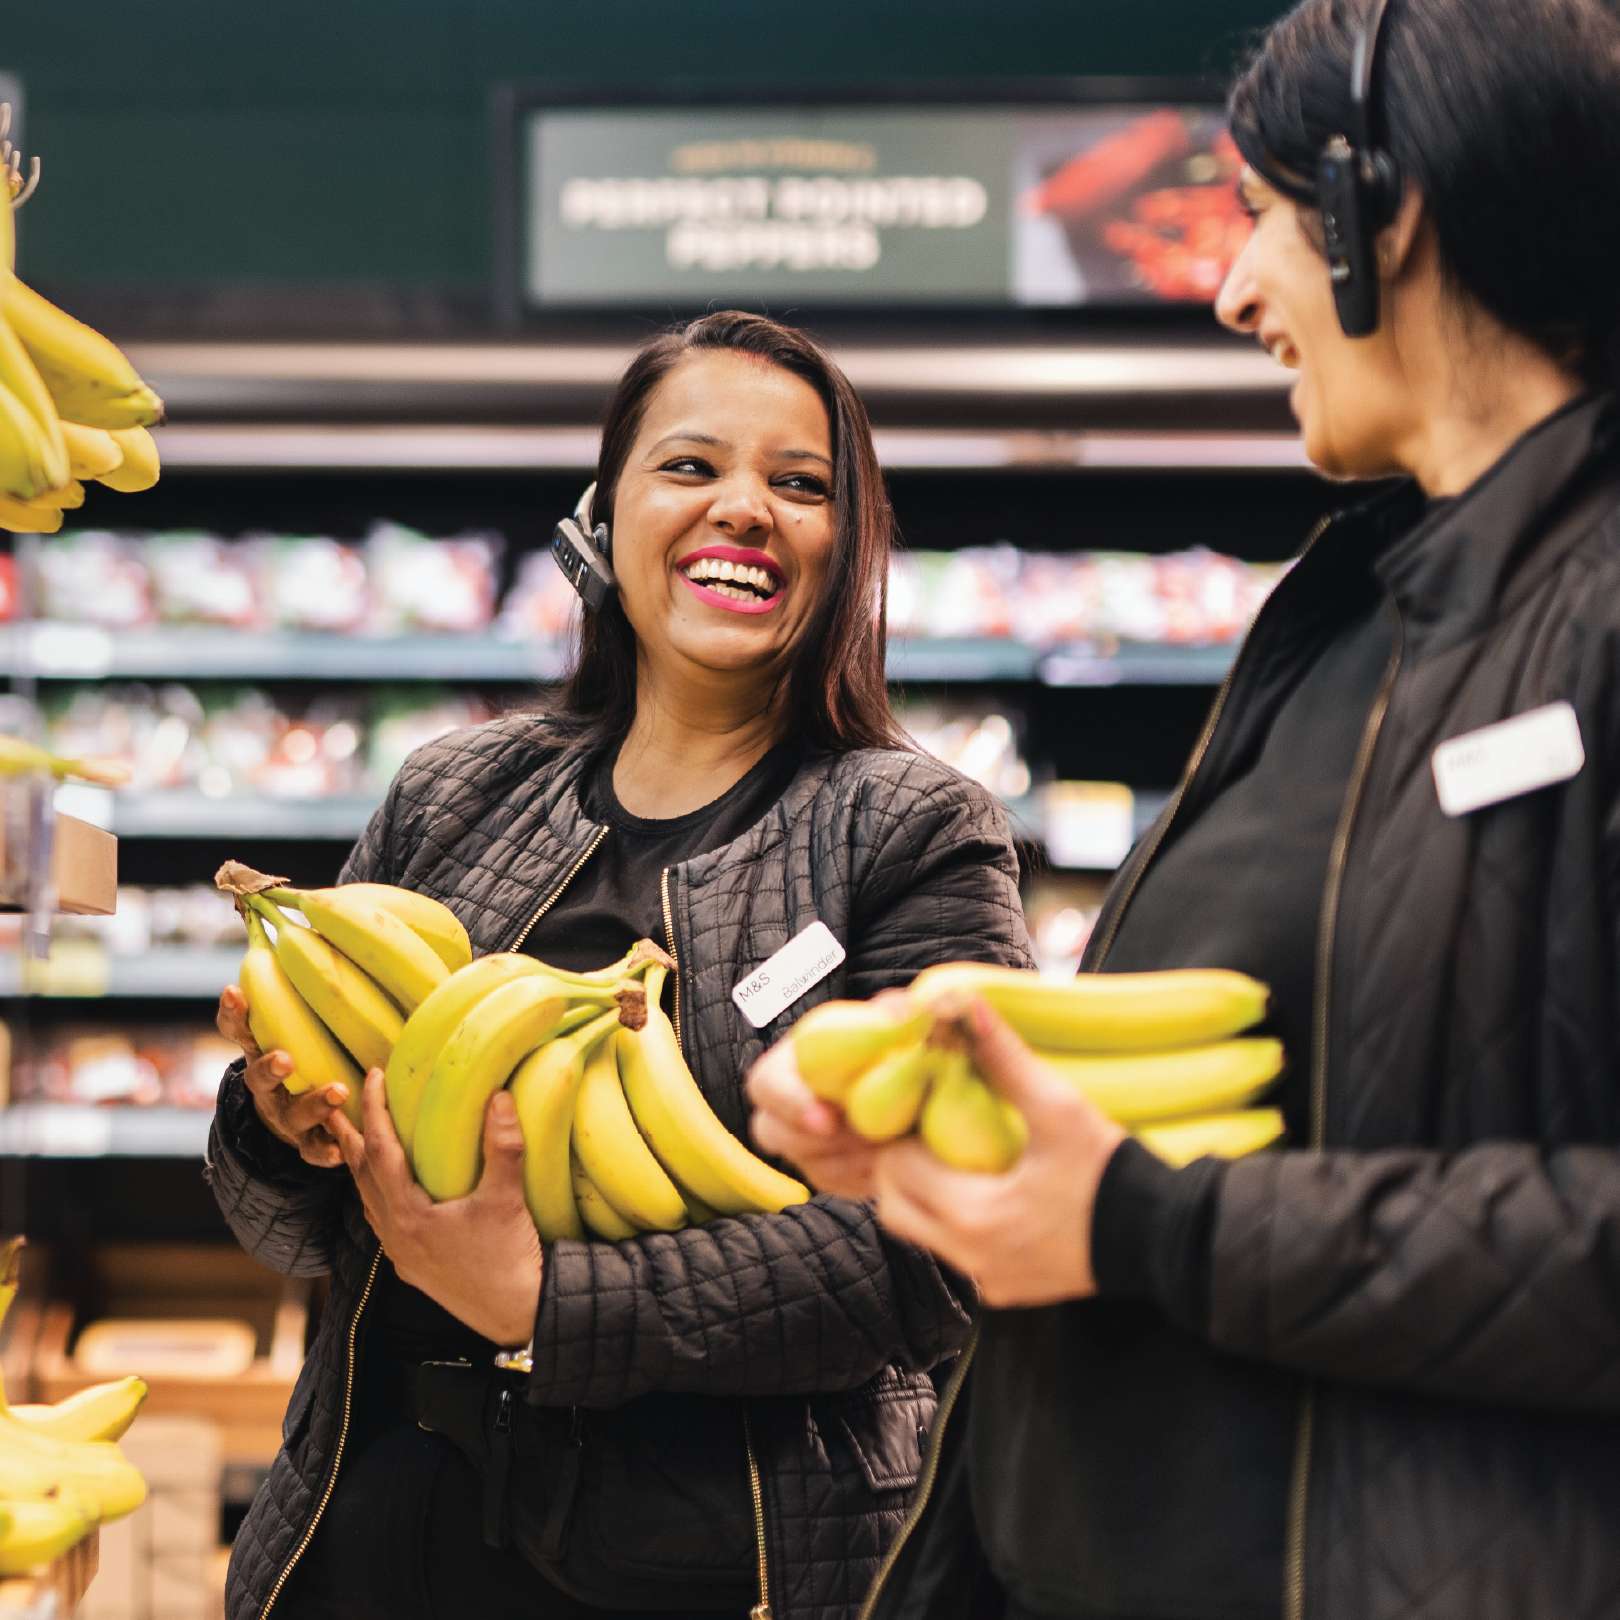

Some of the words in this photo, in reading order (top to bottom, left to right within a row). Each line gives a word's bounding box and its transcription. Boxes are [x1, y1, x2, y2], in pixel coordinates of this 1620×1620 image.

[561, 177, 768, 229] PERFECT
[772, 177, 988, 229] POINTED
[667, 223, 880, 271] PEPPERS
[738, 972, 771, 1003] M&S
[781, 949, 838, 999] Balwinder
